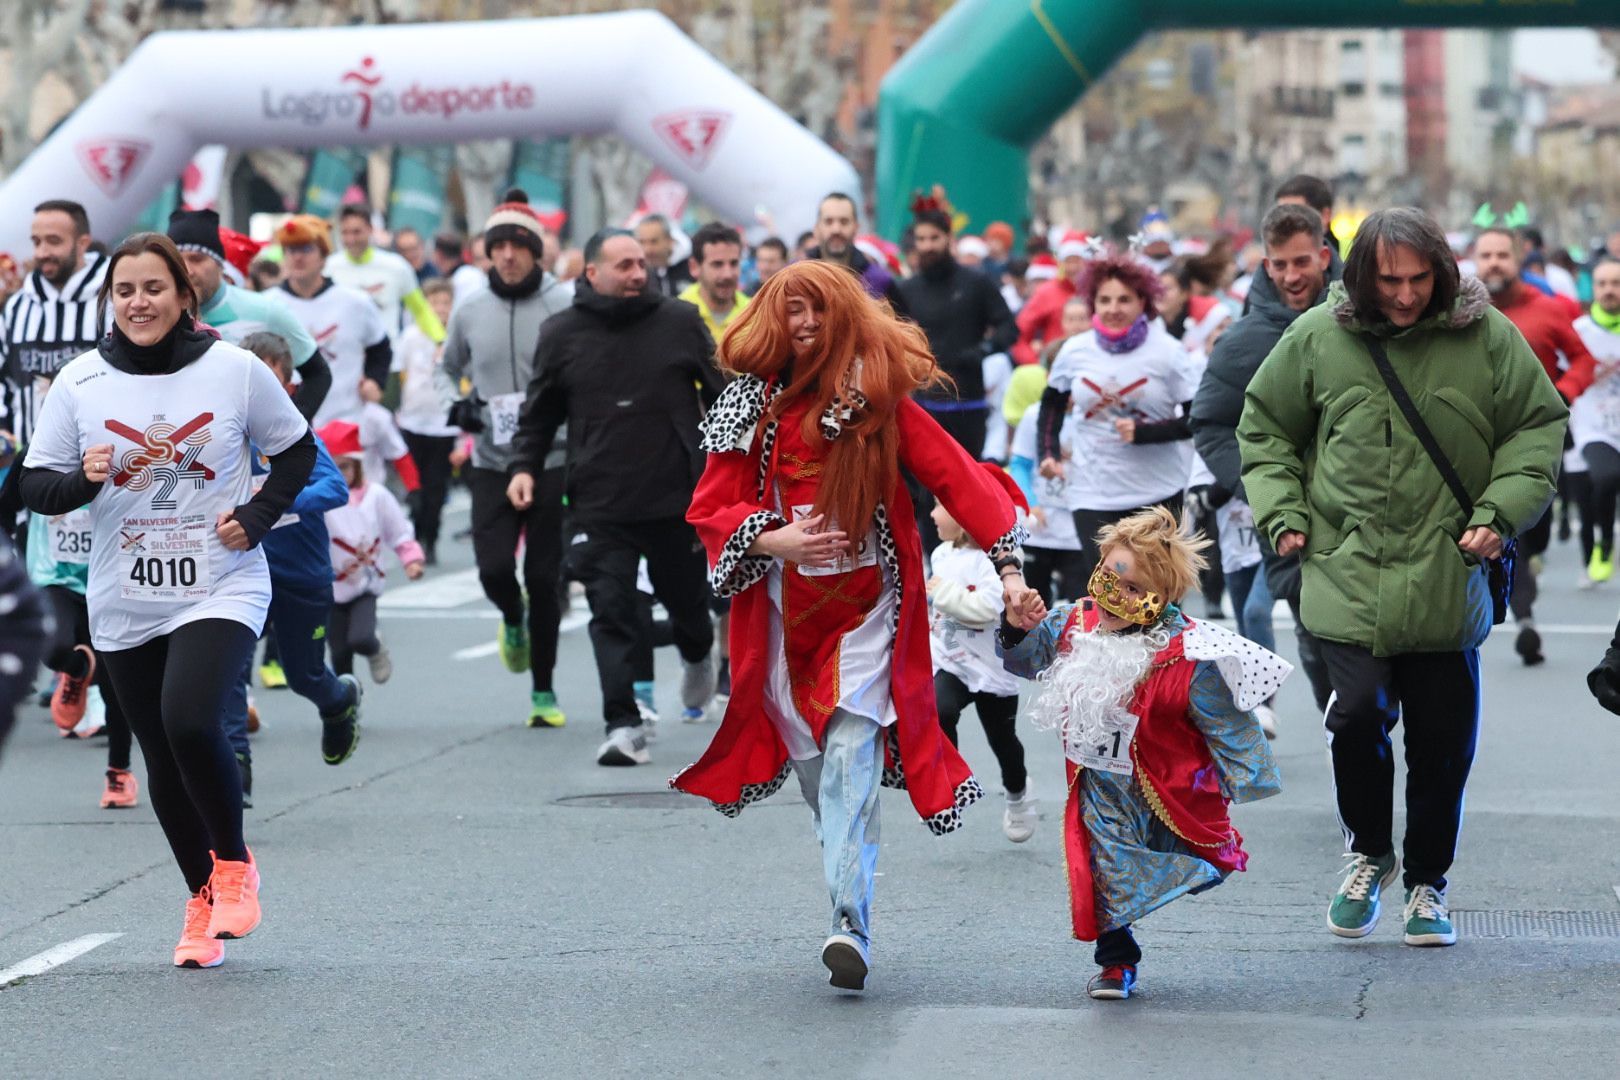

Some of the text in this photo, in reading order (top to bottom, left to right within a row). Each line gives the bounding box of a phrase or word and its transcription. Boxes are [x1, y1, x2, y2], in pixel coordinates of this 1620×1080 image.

[402, 82, 534, 118] deporte
[123, 518, 139, 526] SAN
[140, 517, 178, 526] SILVESTRE
[57, 530, 92, 553] 235
[165, 532, 187, 541] SAN
[150, 540, 203, 550] SILVESTRE
[130, 556, 197, 587] 4010
